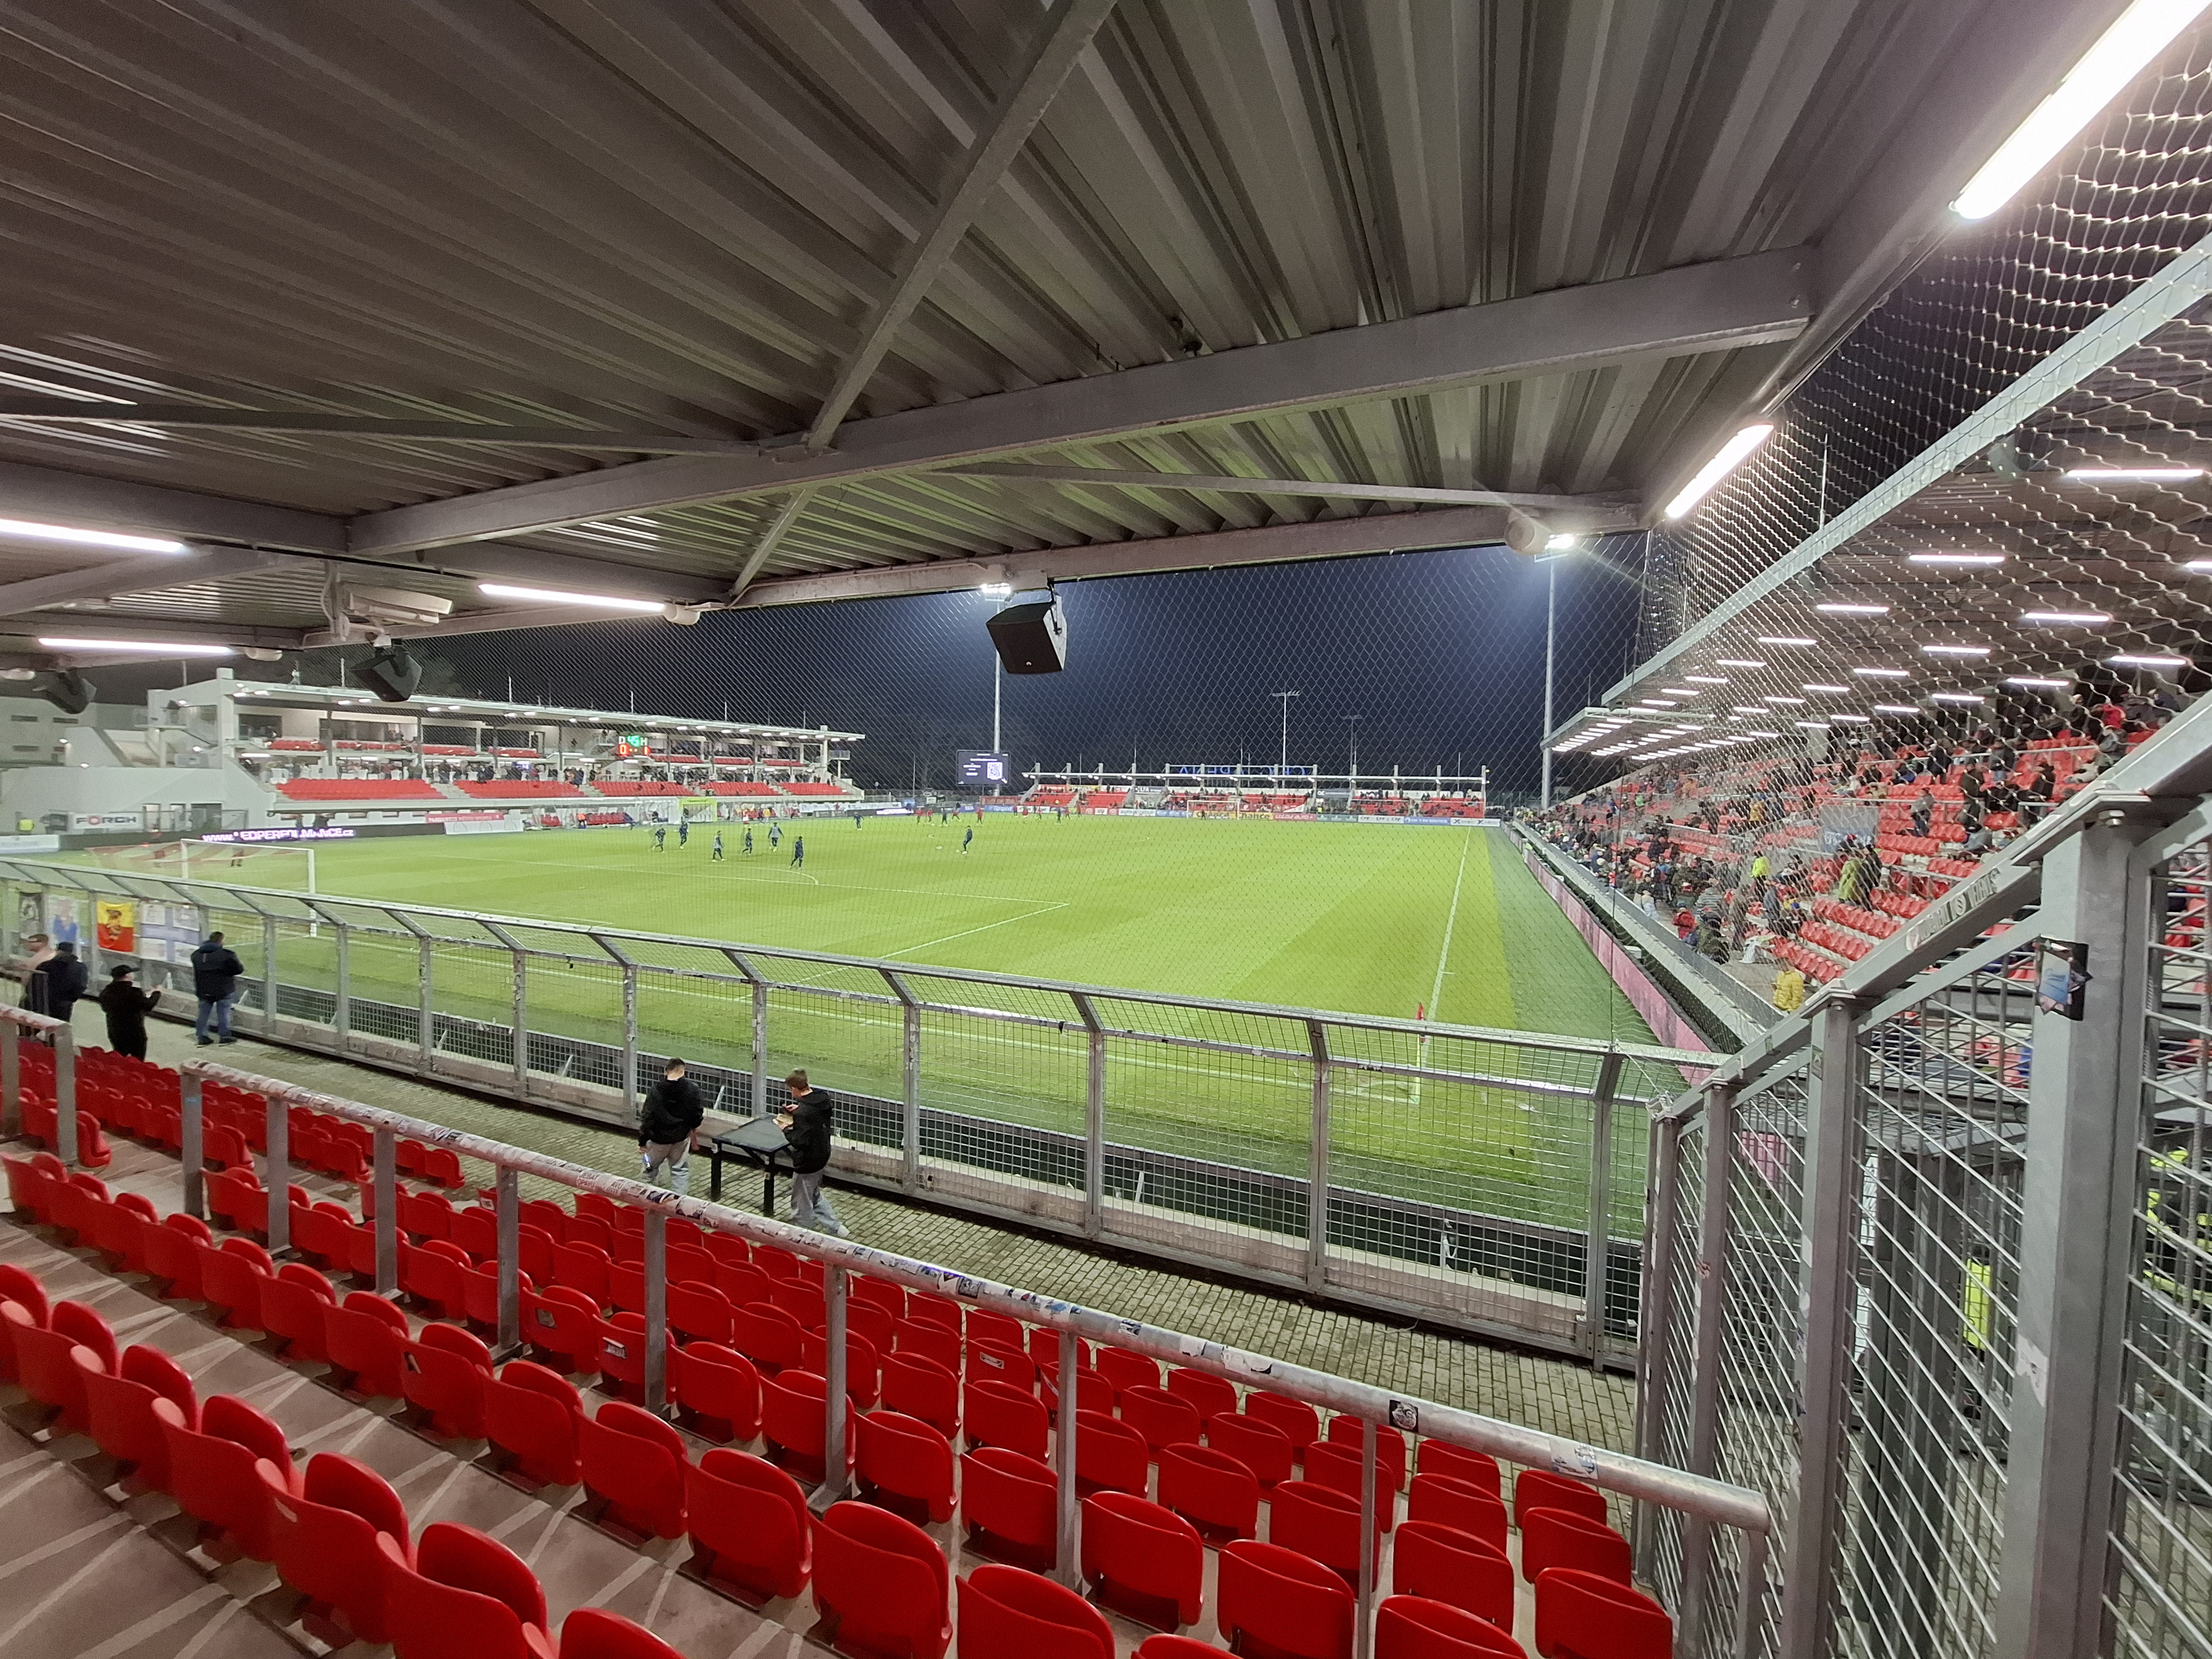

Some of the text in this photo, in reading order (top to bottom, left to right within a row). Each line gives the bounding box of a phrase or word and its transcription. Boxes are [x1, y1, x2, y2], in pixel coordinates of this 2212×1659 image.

[619, 735, 648, 747] D 45 H
[620, 744, 626, 755] 0
